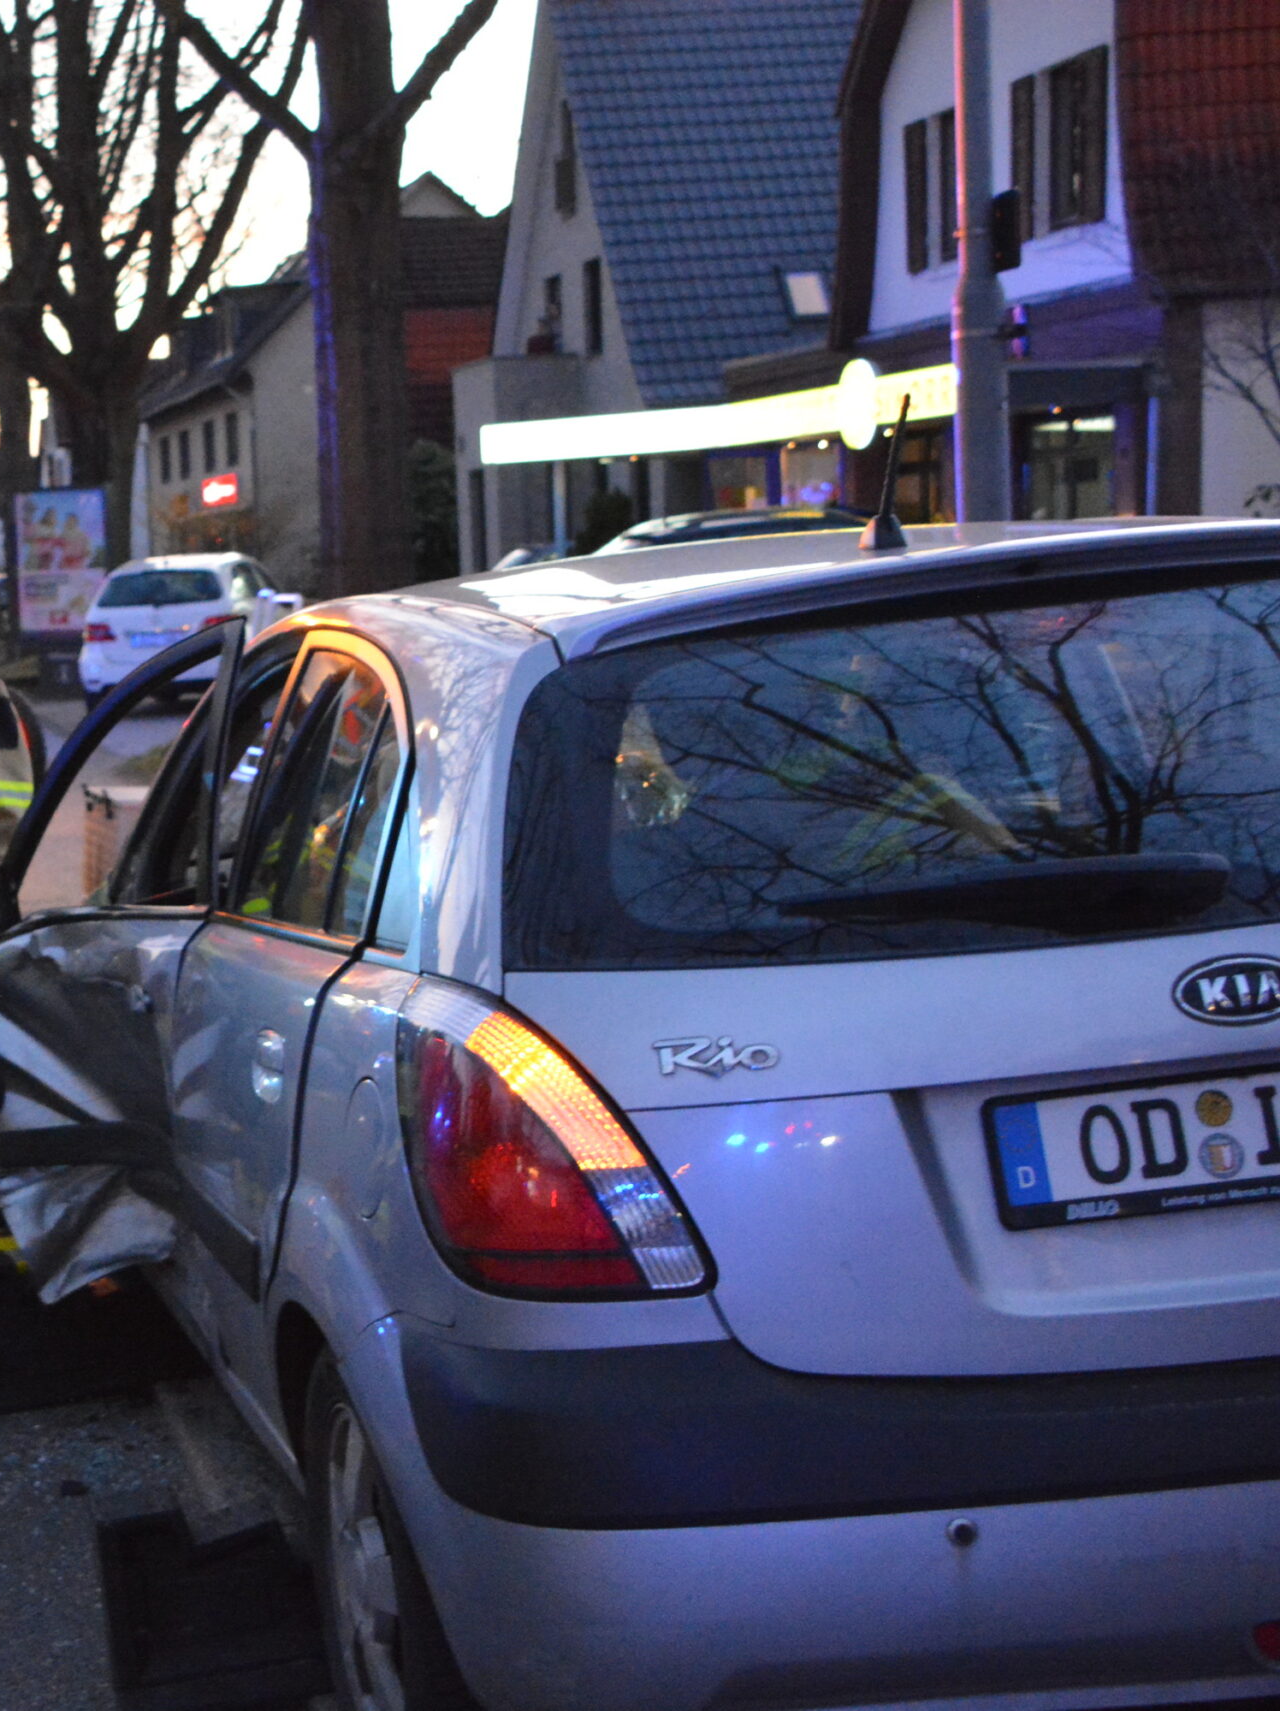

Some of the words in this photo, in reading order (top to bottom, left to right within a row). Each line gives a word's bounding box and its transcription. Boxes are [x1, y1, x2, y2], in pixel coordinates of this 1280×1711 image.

[1196, 970, 1280, 1012] KIA
[652, 1035, 781, 1079] Rio
[1079, 1098, 1189, 1184] OD
[1017, 1166, 1037, 1189] D
